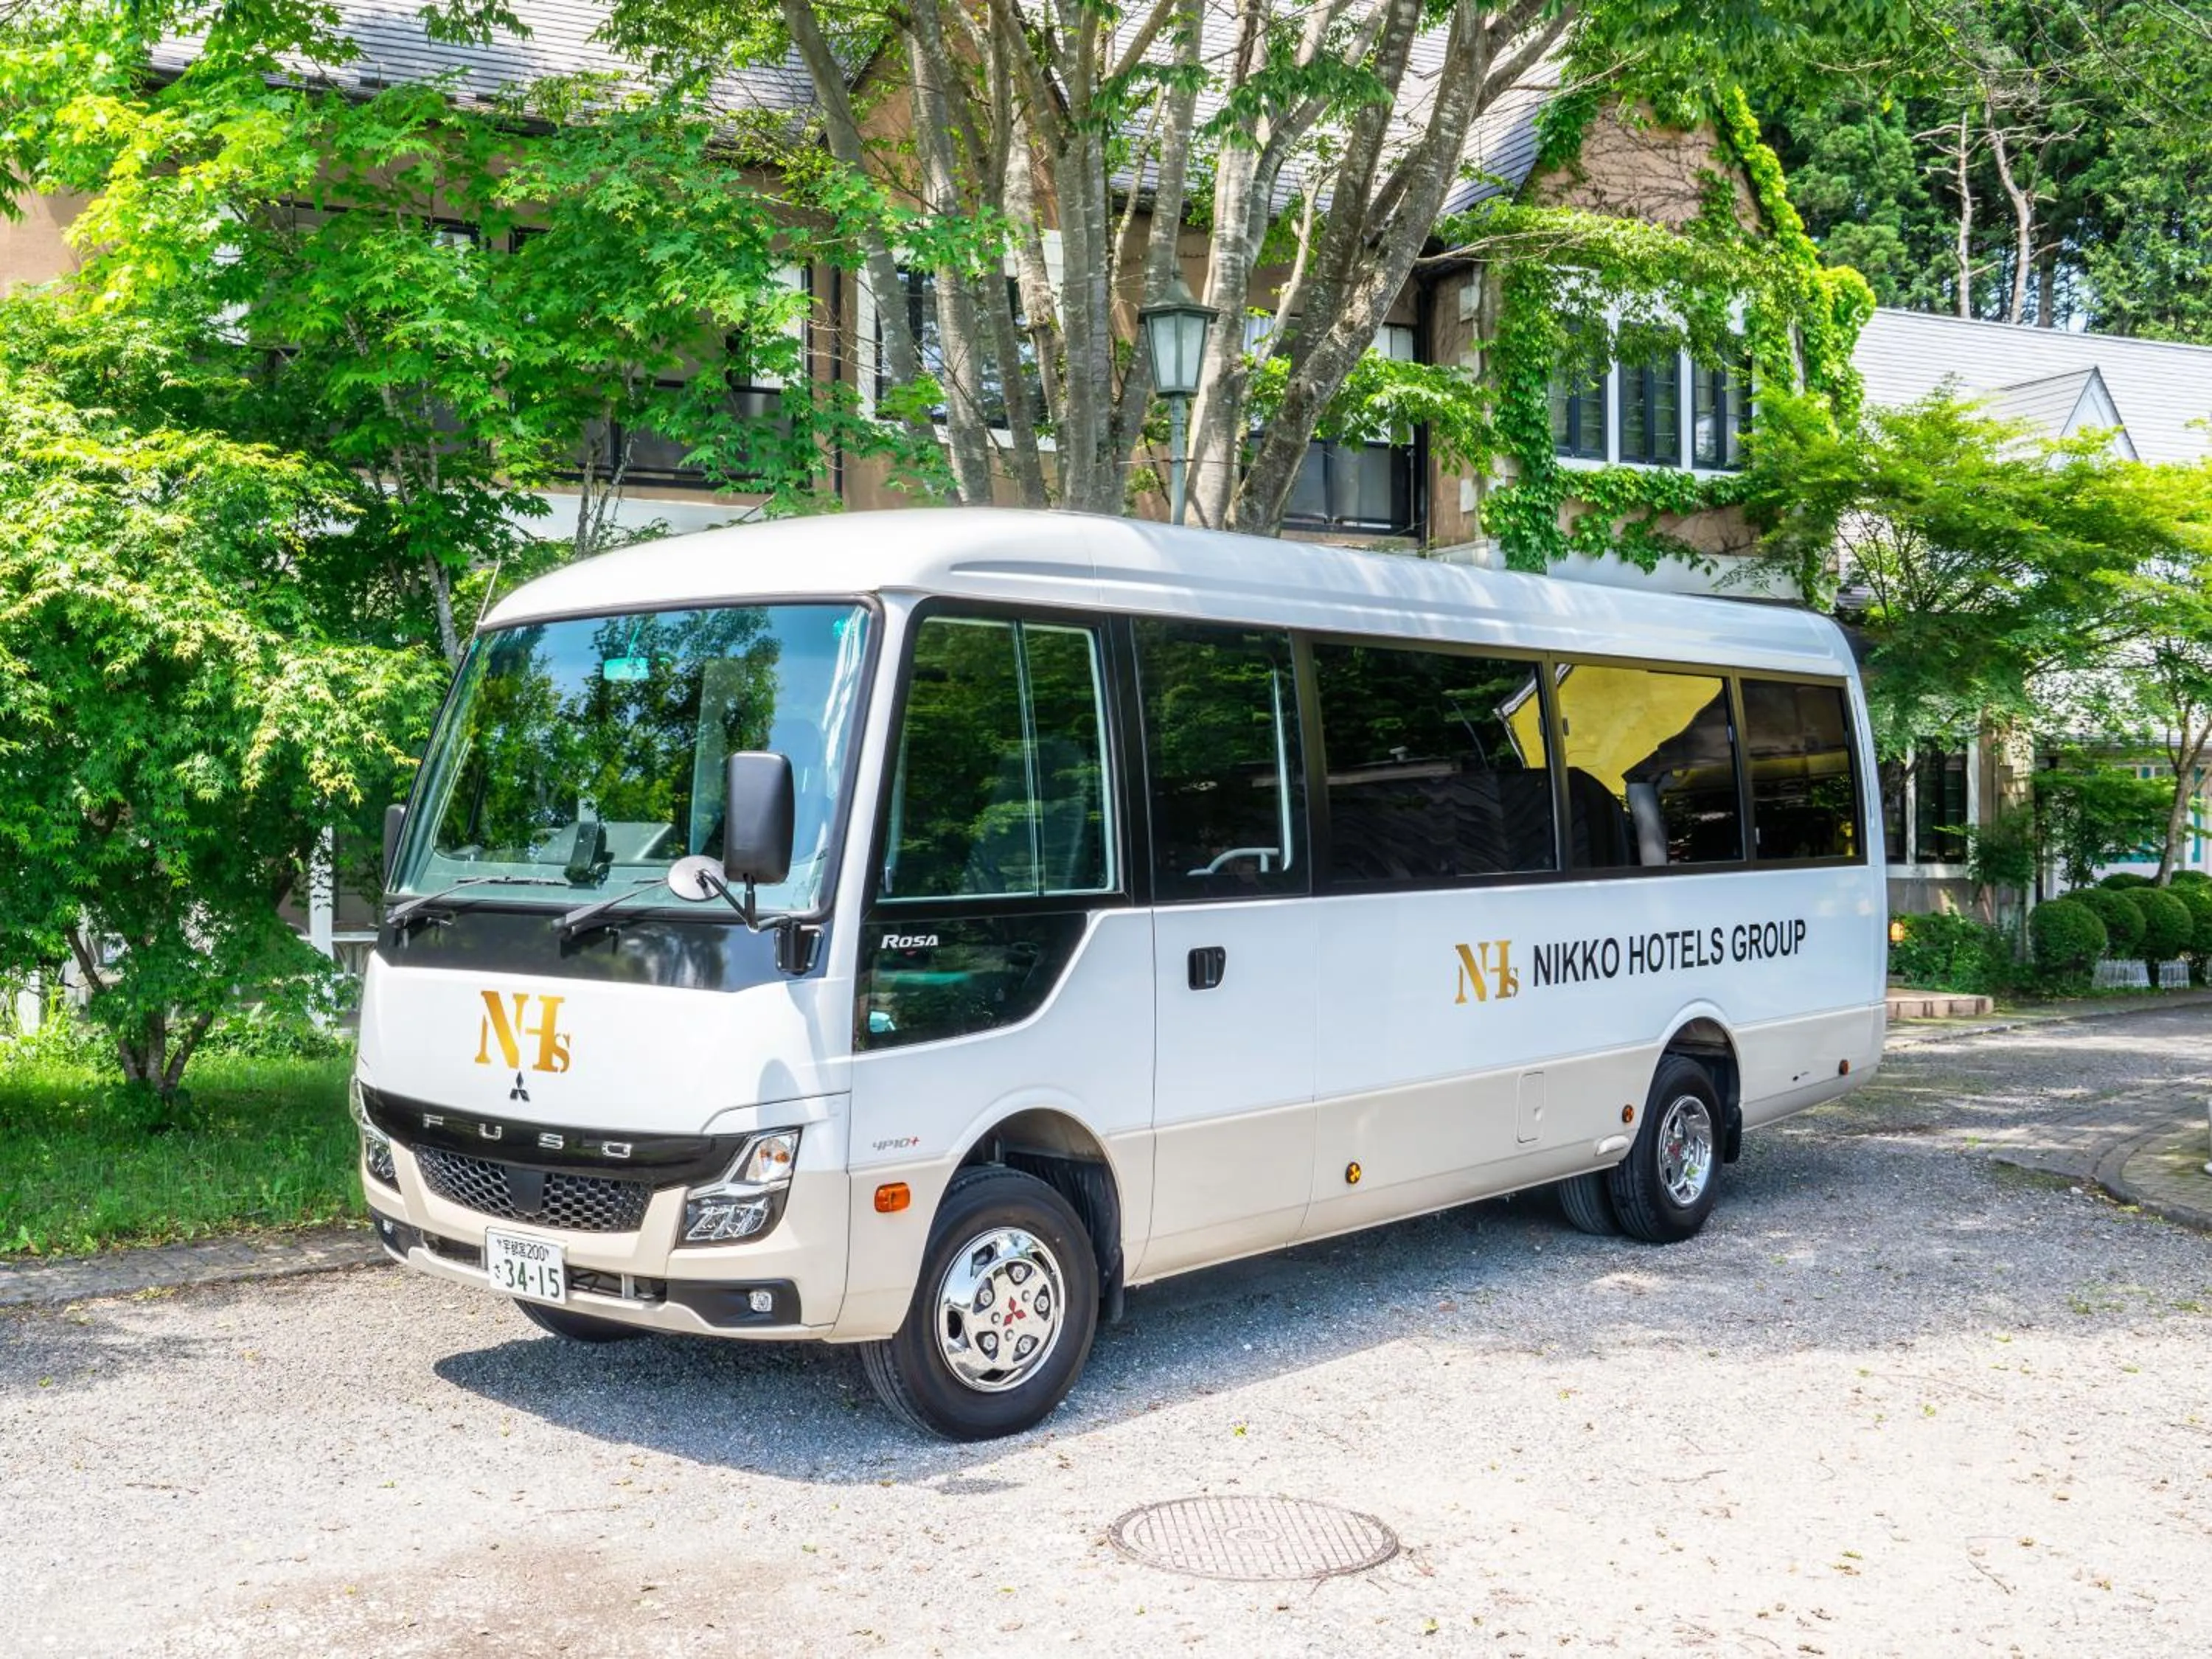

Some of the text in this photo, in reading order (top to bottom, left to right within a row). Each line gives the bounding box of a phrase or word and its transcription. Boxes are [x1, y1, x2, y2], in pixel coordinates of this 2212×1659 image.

[1533, 919, 1806, 987] NIKKO HOTELS GROUP
[423, 1113, 632, 1158] FUSO
[504, 1259, 560, 1298] 34-15
